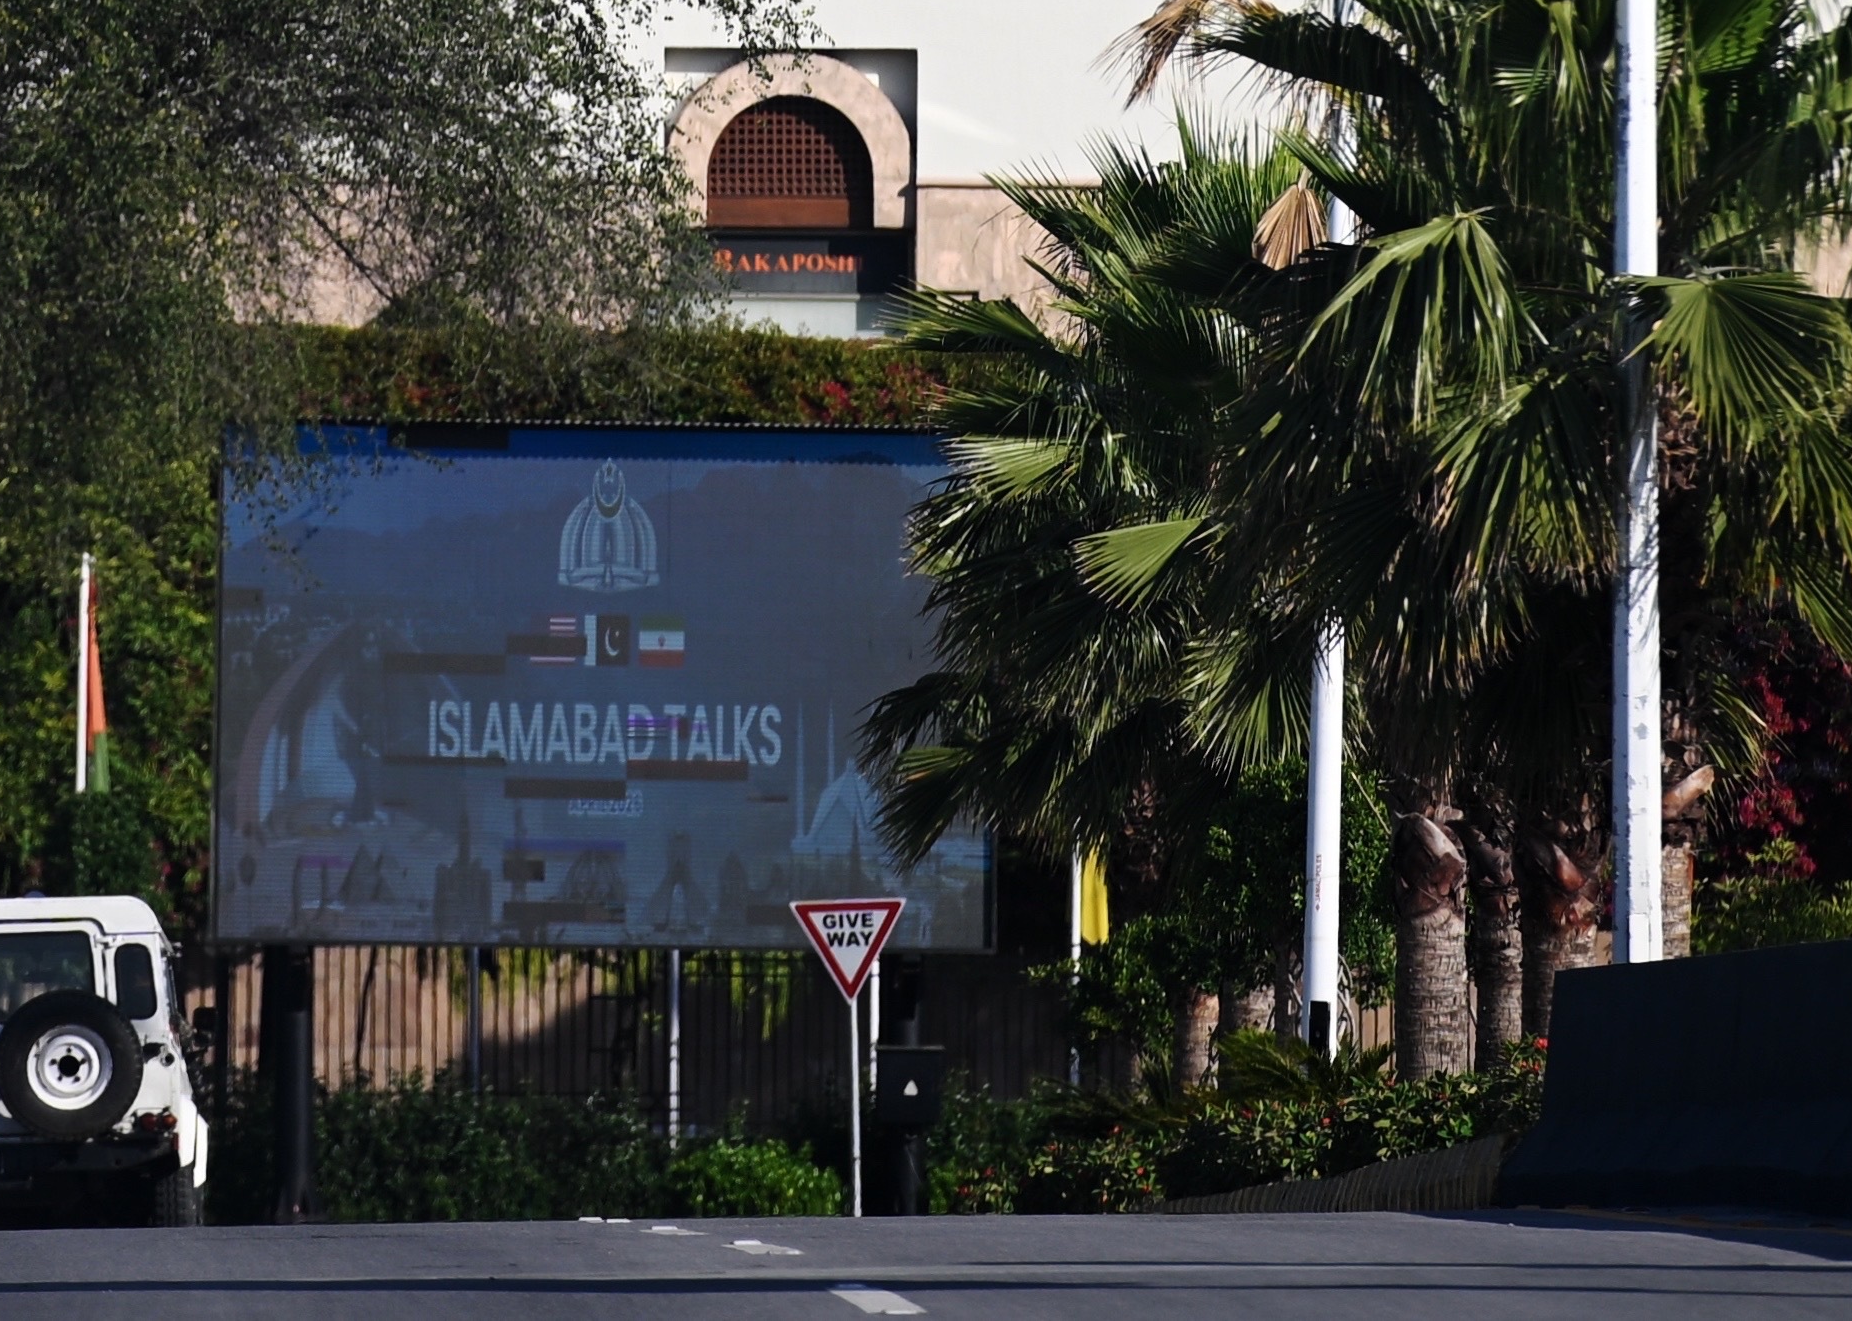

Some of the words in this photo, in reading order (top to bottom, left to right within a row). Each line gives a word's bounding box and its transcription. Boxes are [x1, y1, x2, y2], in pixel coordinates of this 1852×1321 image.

[428, 699, 654, 763] ISLAMABAD
[663, 703, 782, 765] TALKS
[822, 912, 874, 930] GIVE
[827, 931, 874, 948] WAY
